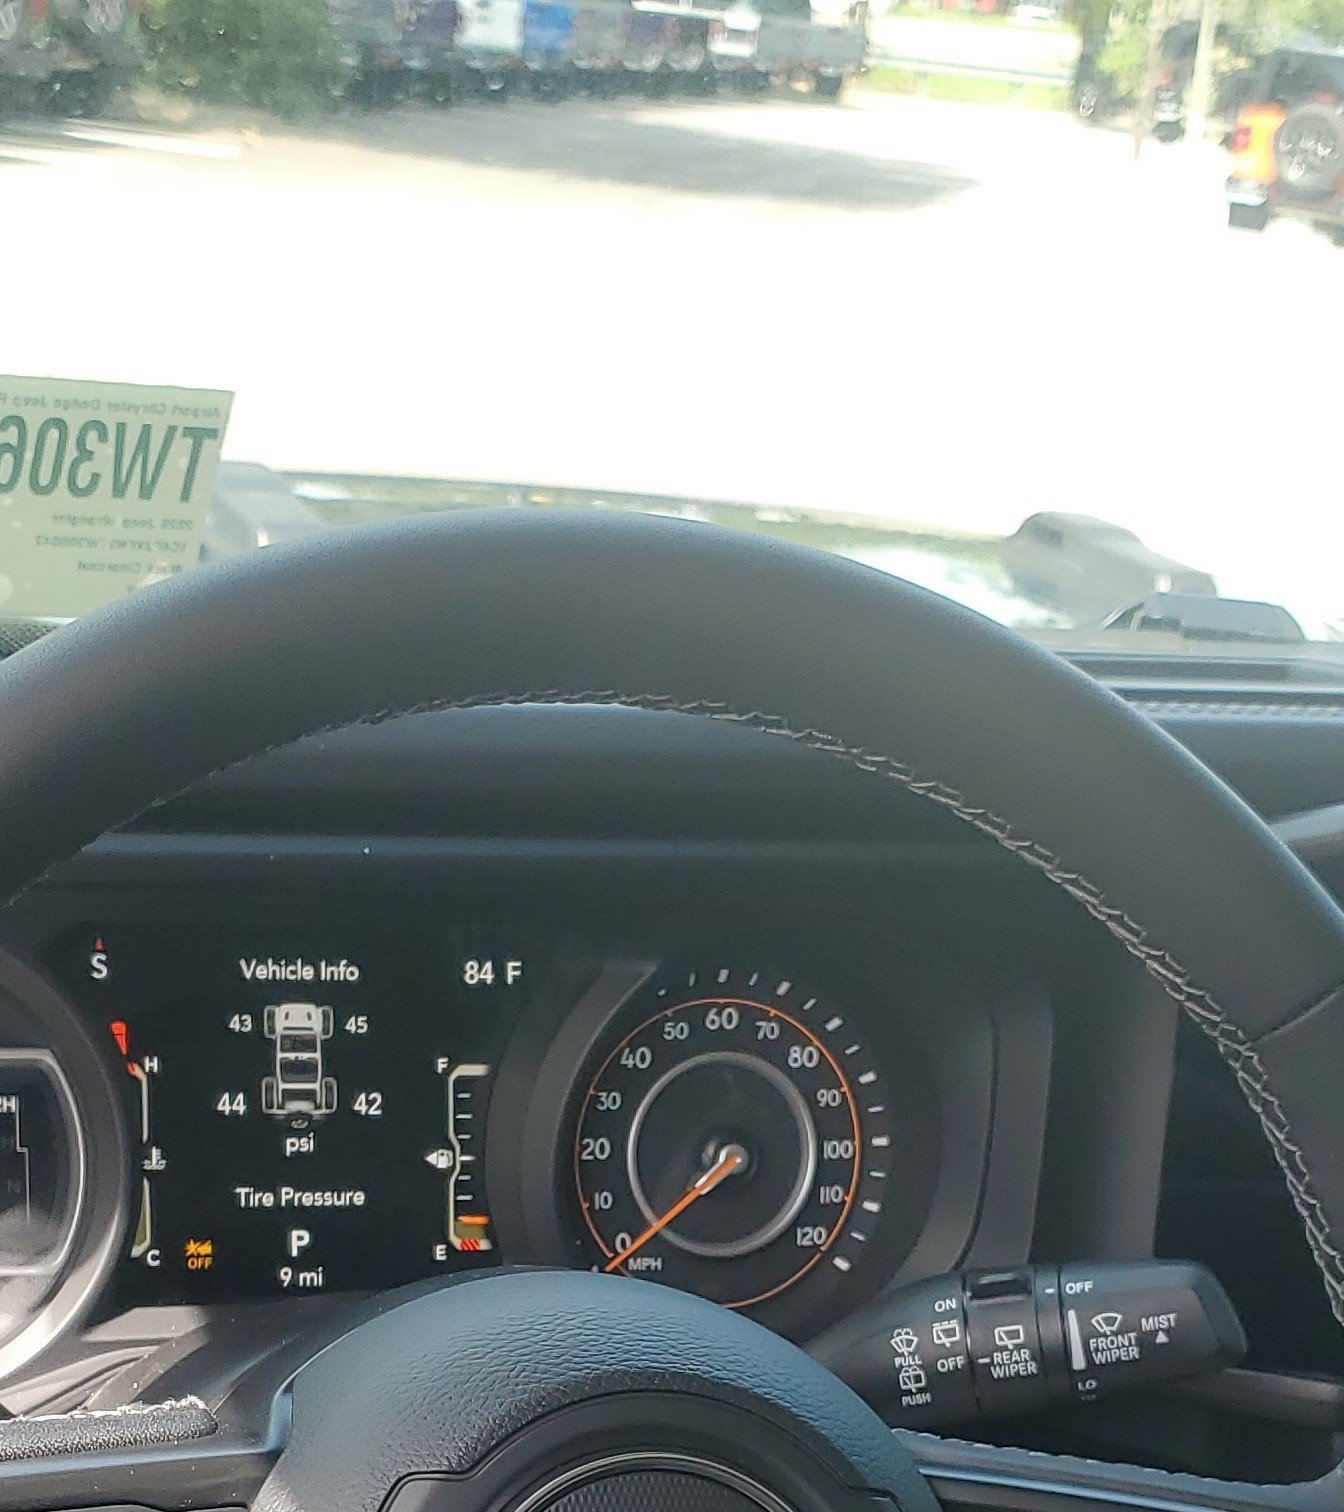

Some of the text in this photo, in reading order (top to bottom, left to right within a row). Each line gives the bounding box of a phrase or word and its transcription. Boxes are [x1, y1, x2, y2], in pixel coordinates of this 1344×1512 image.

[89, 953, 108, 979] S
[238, 957, 359, 981] Vehicle Info
[463, 961, 522, 984] 84 F
[228, 1014, 252, 1032] 43
[342, 1015, 369, 1034] 45
[705, 1006, 739, 1030] 60
[663, 1021, 689, 1041] 50
[755, 1021, 781, 1041] 70
[143, 1055, 158, 1073] H
[436, 1057, 449, 1073] F
[620, 1045, 652, 1069] 40
[787, 1044, 820, 1068] 80
[216, 1092, 246, 1114] 44
[353, 1092, 382, 1115] 42
[595, 1091, 622, 1111] 30
[816, 1088, 842, 1107] 90
[285, 1131, 315, 1156] psi
[580, 1136, 611, 1160] 20
[822, 1140, 853, 1160] 100
[233, 1186, 365, 1207] Tire Pressure
[593, 1191, 613, 1210] 10
[818, 1185, 843, 1204] 110
[289, 1229, 311, 1256] P
[614, 1231, 631, 1253] 0
[796, 1227, 827, 1247] 120
[145, 1249, 160, 1267] C
[434, 1245, 447, 1261] E
[186, 1257, 213, 1271] OFF
[628, 1256, 662, 1271] MPH
[279, 1266, 324, 1286] 9 mi
[1065, 1280, 1093, 1295] OFF
[934, 1297, 956, 1312] ON
[1141, 1312, 1177, 1333] MIST
[1088, 1331, 1137, 1351] FRONT
[894, 1353, 922, 1367] PULL
[936, 1355, 965, 1372] OFF
[992, 1349, 1031, 1365] REAR
[1091, 1345, 1140, 1365] WIPER
[990, 1360, 1038, 1379] WIPER
[901, 1391, 931, 1407] PUSH
